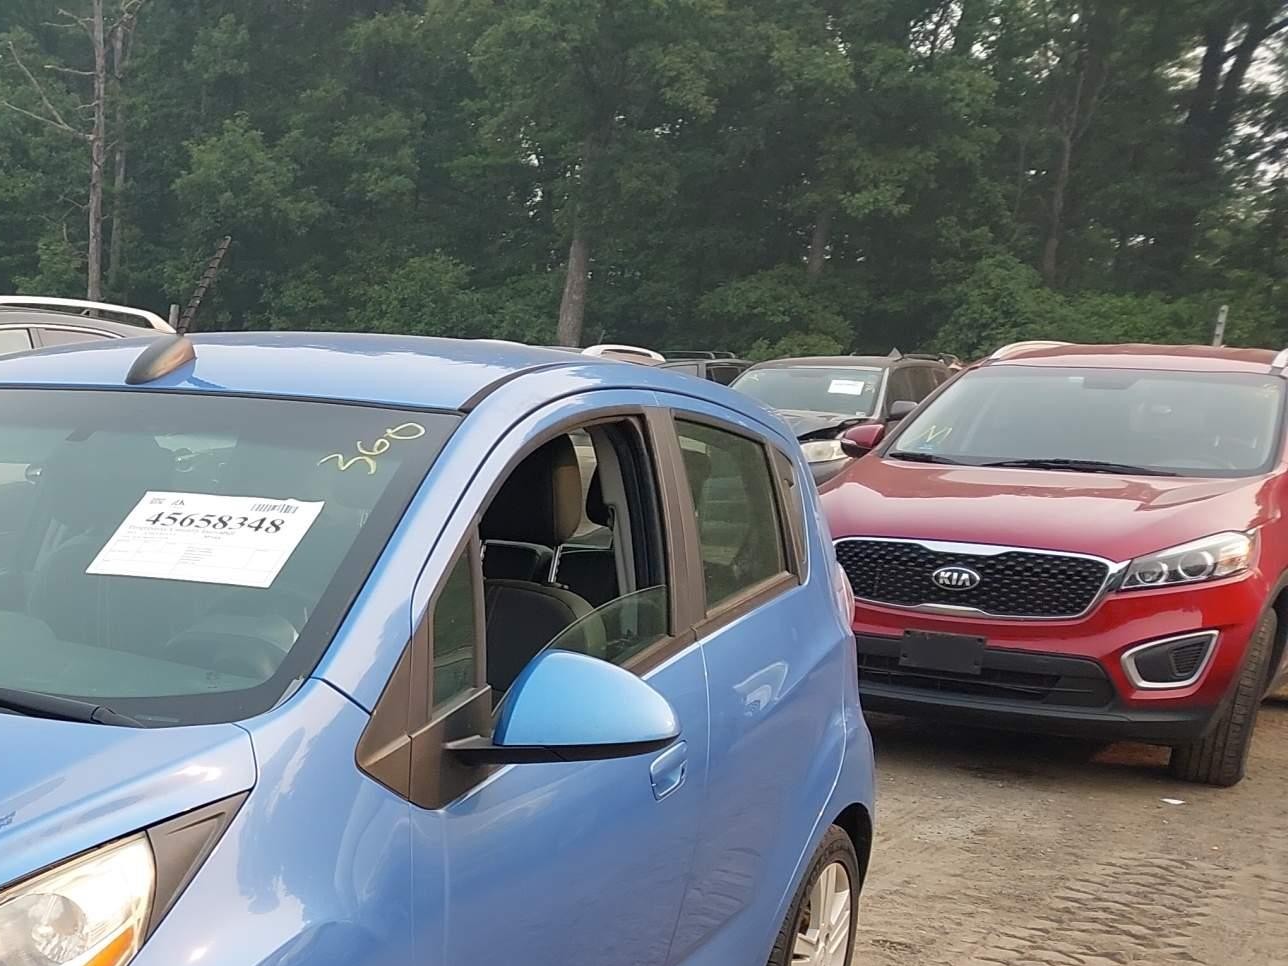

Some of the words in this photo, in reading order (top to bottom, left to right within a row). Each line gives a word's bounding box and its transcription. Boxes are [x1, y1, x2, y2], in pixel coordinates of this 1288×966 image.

[316, 422, 426, 475] 360
[144, 511, 285, 534] 45658348
[938, 571, 971, 587] KIA
